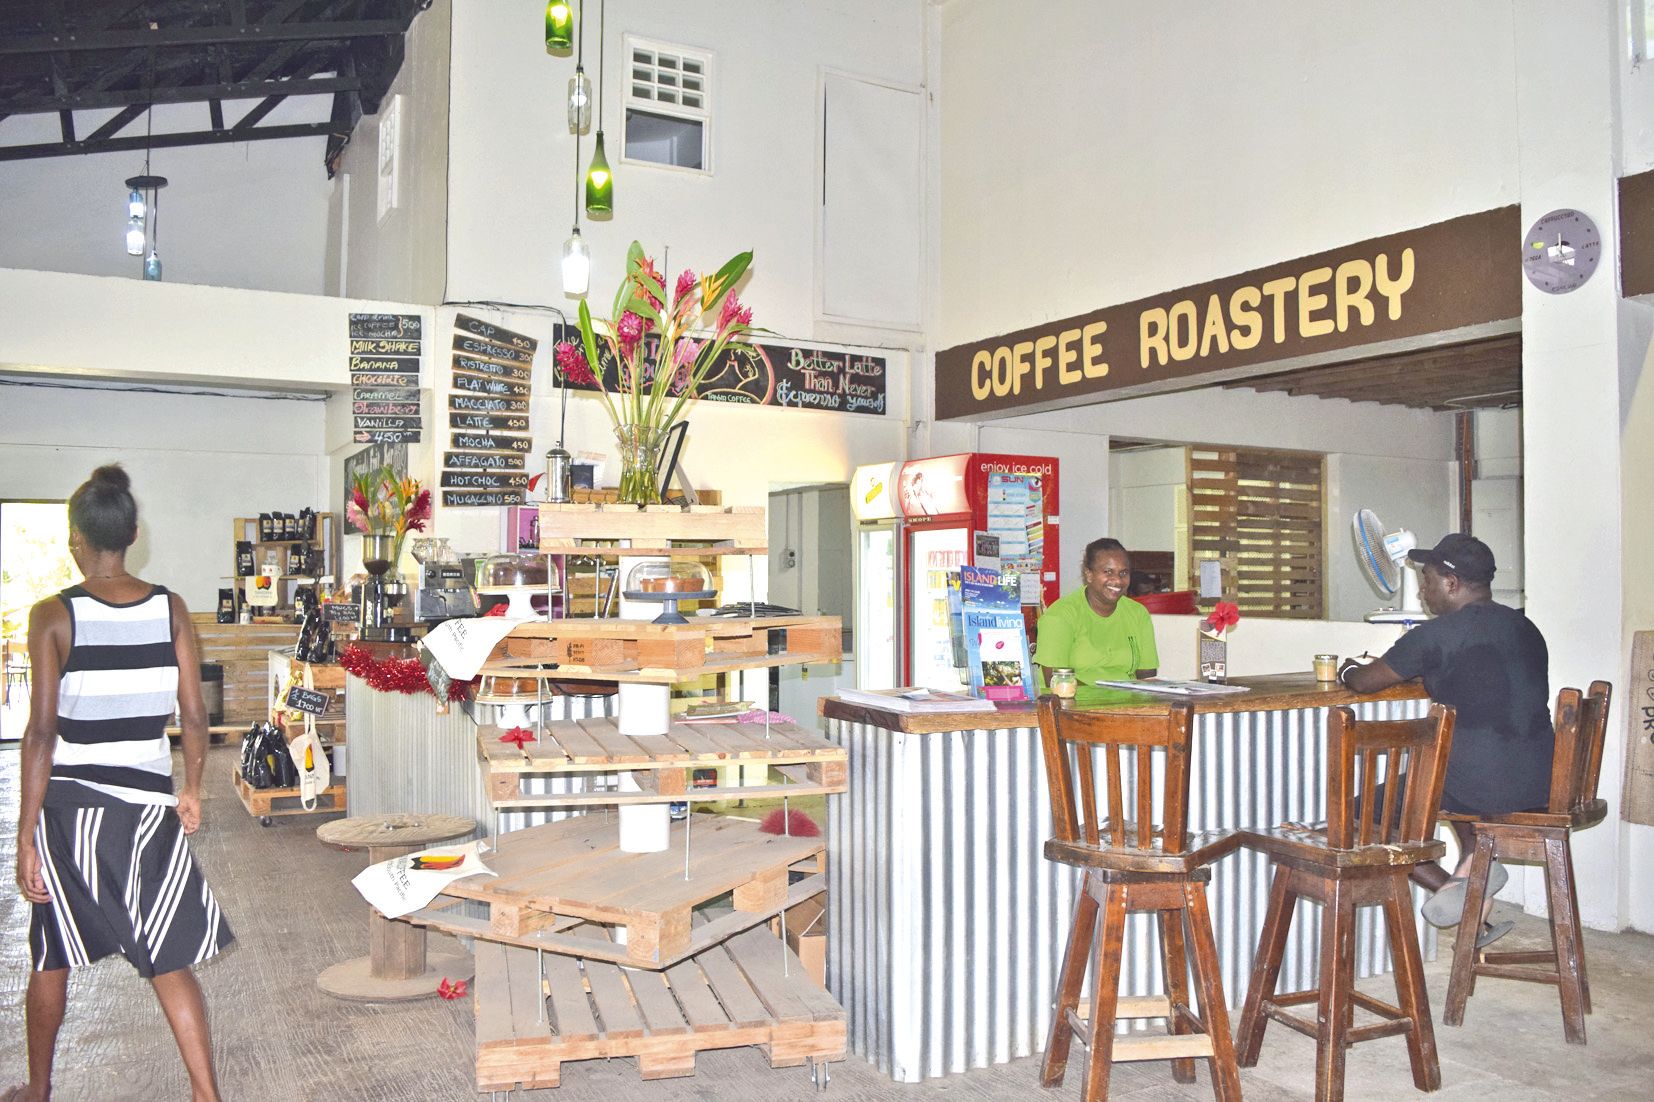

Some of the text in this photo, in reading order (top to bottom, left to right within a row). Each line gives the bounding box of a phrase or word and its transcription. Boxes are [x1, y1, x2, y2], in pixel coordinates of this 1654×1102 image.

[402, 319, 420, 329] 500
[469, 321, 495, 336] CAP
[971, 247, 1416, 401] COFFEE ROASTERY
[463, 340, 515, 359] ESPRESSO
[459, 358, 530, 378] RISTRETTO 300
[787, 348, 883, 376] Better Latte
[457, 377, 482, 391] FLAT
[485, 380, 510, 394] WHITE
[801, 369, 876, 397] Than Never
[455, 397, 506, 409] MACCIATO
[457, 416, 526, 428] LATTE 450
[374, 431, 402, 444] 450
[458, 436, 529, 449] MOCHA 450
[449, 455, 506, 467] AFFAGATO
[981, 461, 1052, 475] enjoy ice cold
[450, 475, 528, 486] HOT CHOC 450
[503, 494, 521, 503] 550
[964, 571, 996, 586] ISLAND
[997, 575, 1017, 587] LIFE
